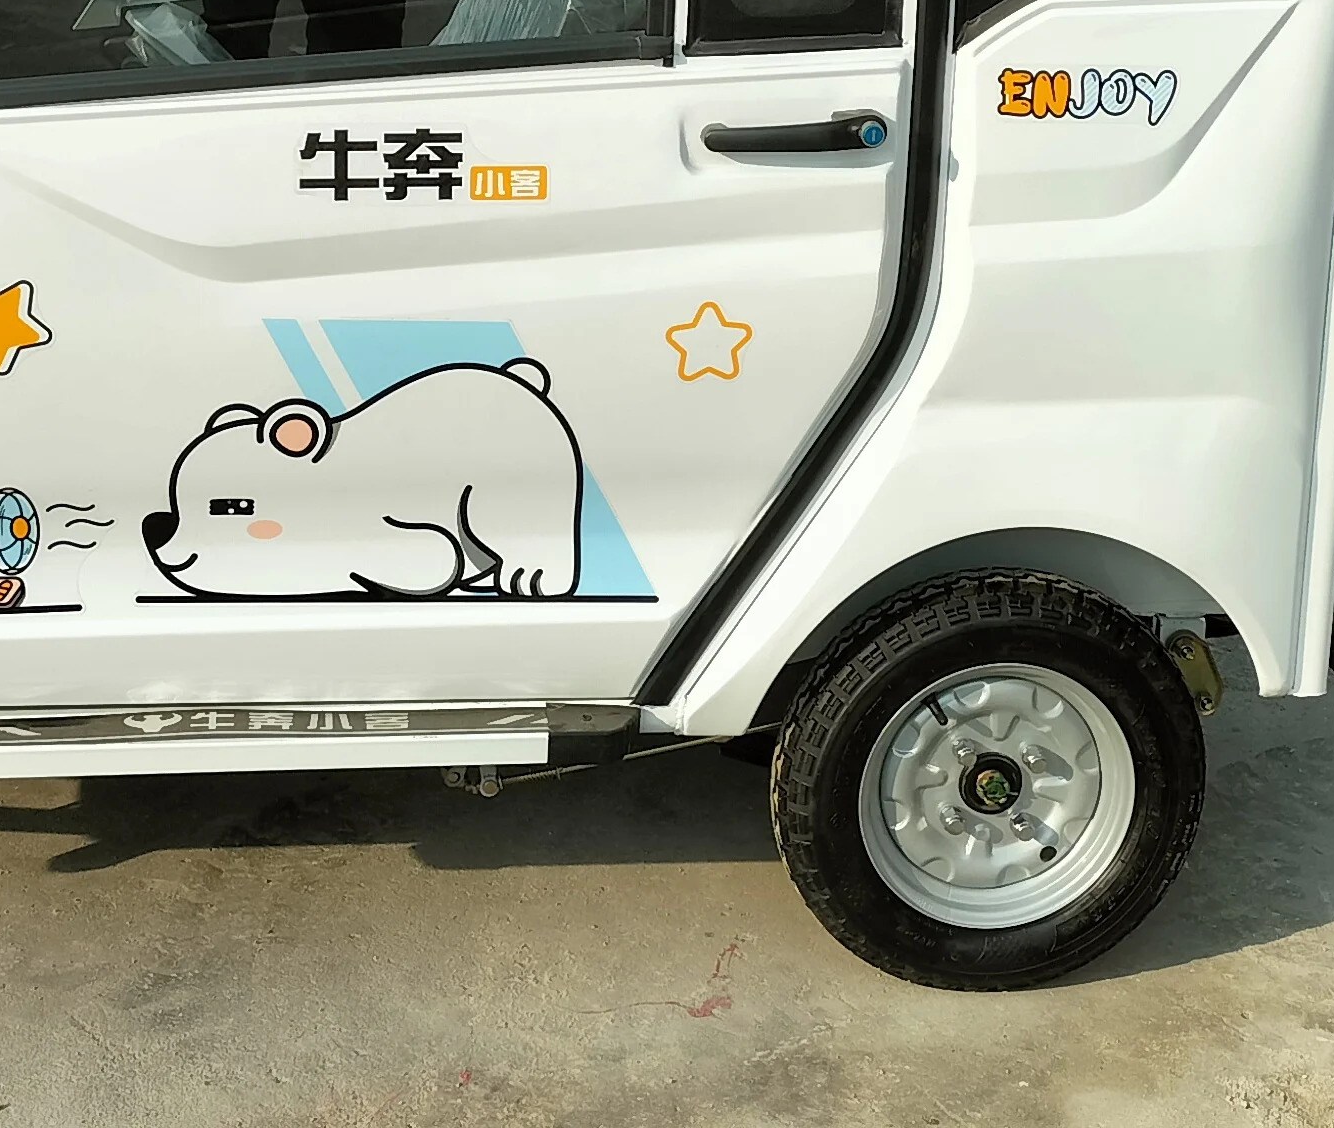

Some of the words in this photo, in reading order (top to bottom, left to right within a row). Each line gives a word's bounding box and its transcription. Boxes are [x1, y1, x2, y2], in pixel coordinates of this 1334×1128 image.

[998, 68, 1178, 126] ENJOY
[299, 128, 464, 201] 牛奔
[475, 169, 541, 197] 小客
[190, 711, 409, 730] 牛奔小客
